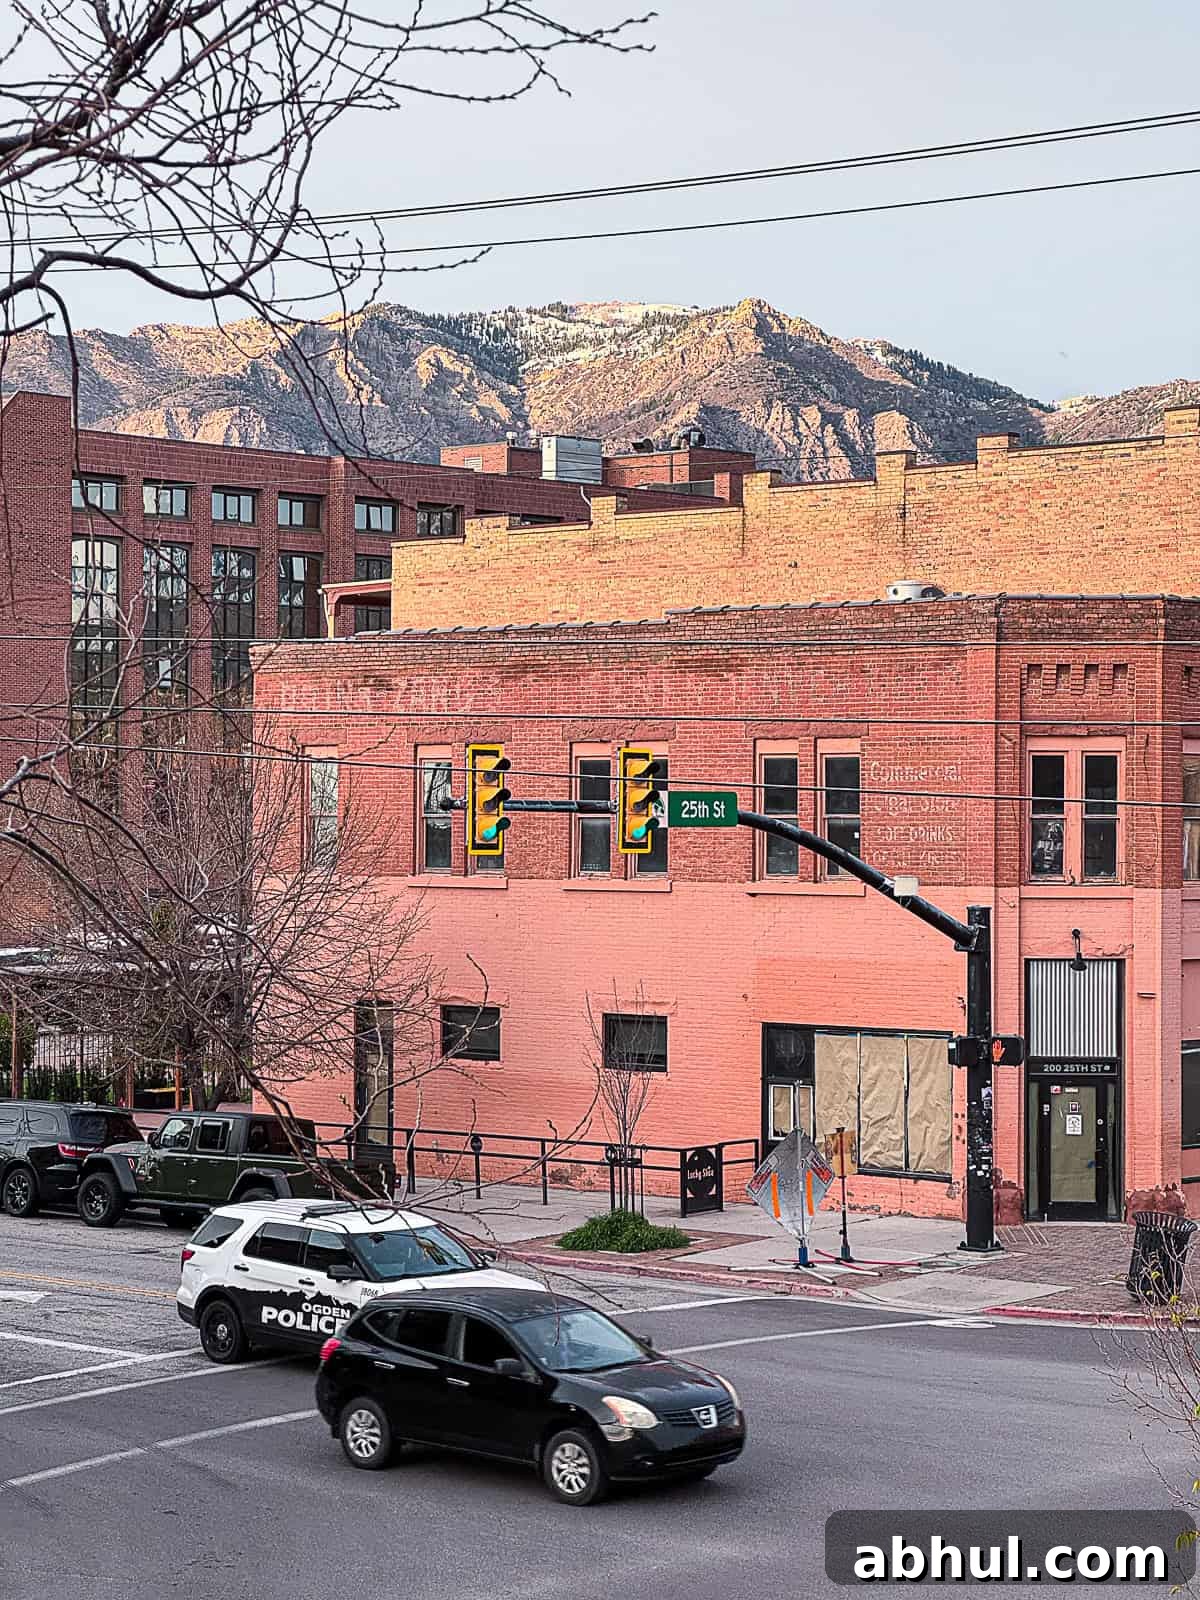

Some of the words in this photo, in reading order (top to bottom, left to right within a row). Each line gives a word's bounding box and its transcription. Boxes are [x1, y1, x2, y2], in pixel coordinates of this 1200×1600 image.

[681, 800, 709, 818] 25th
[713, 800, 725, 818] St
[1043, 1063, 1061, 1073] 200
[1063, 1063, 1088, 1073] 25TH
[1090, 1063, 1104, 1073] ST
[301, 1302, 351, 1318] OGDEN
